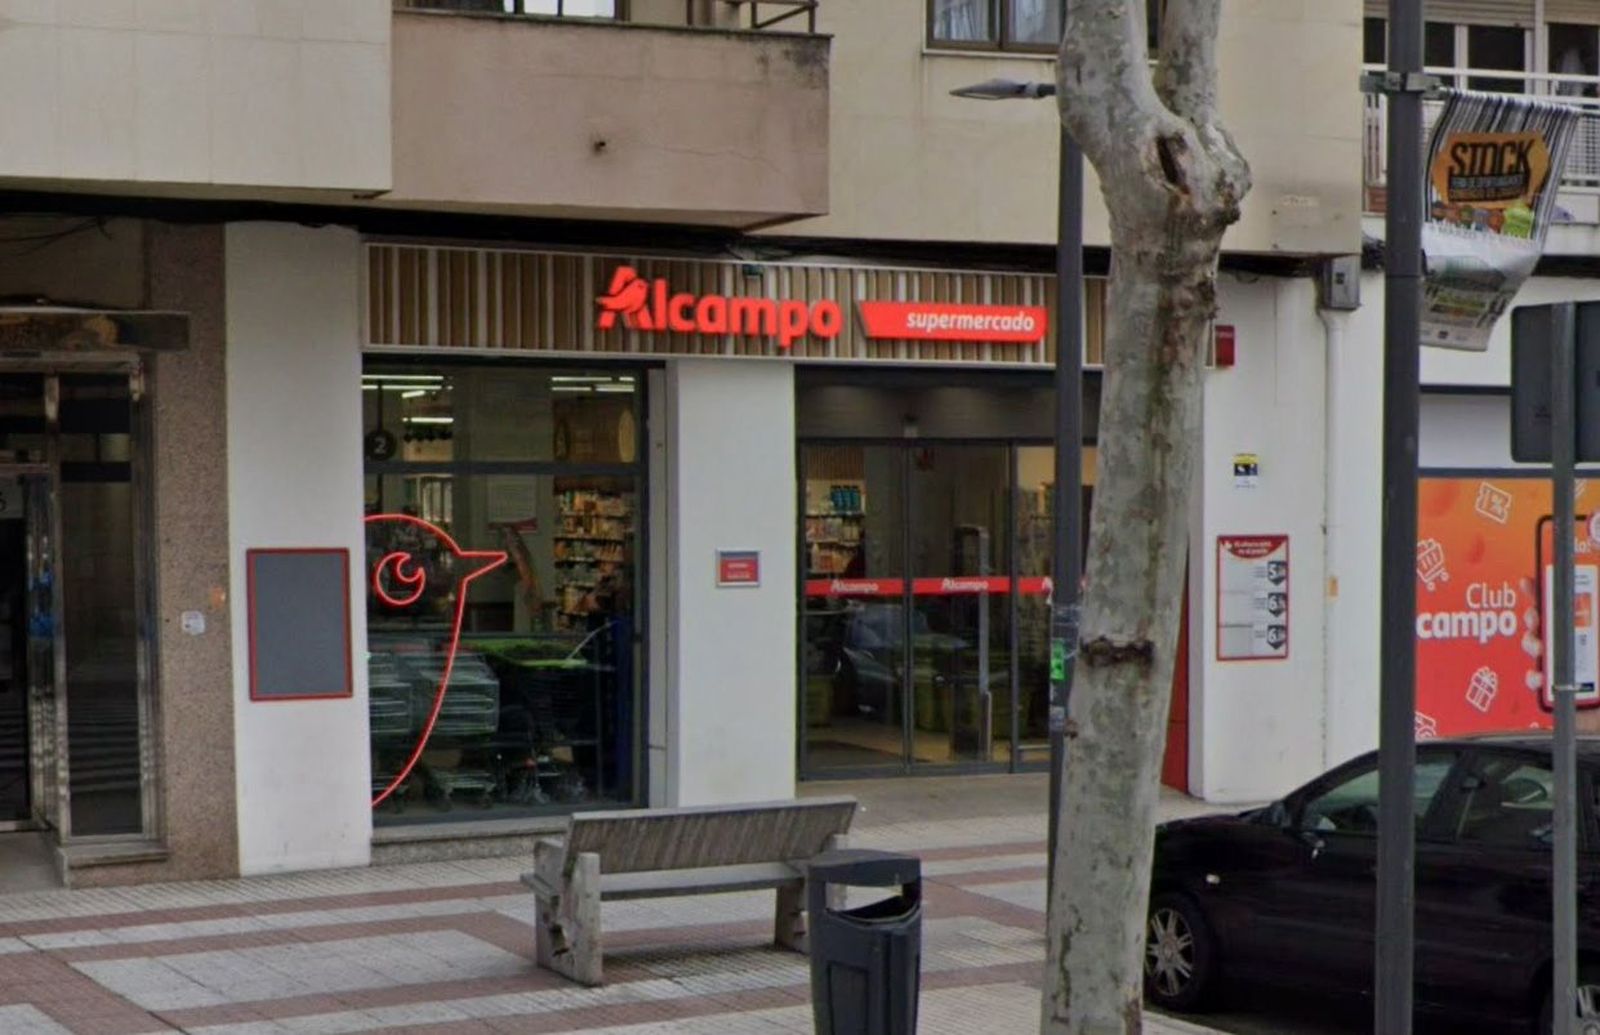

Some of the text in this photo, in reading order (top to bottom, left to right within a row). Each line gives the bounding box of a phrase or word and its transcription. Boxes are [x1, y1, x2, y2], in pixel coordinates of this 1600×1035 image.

[1449, 139, 1535, 177] STOCK
[596, 266, 841, 348] Alcampo
[907, 310, 1035, 332] supermercado
[1466, 582, 1517, 610] Club
